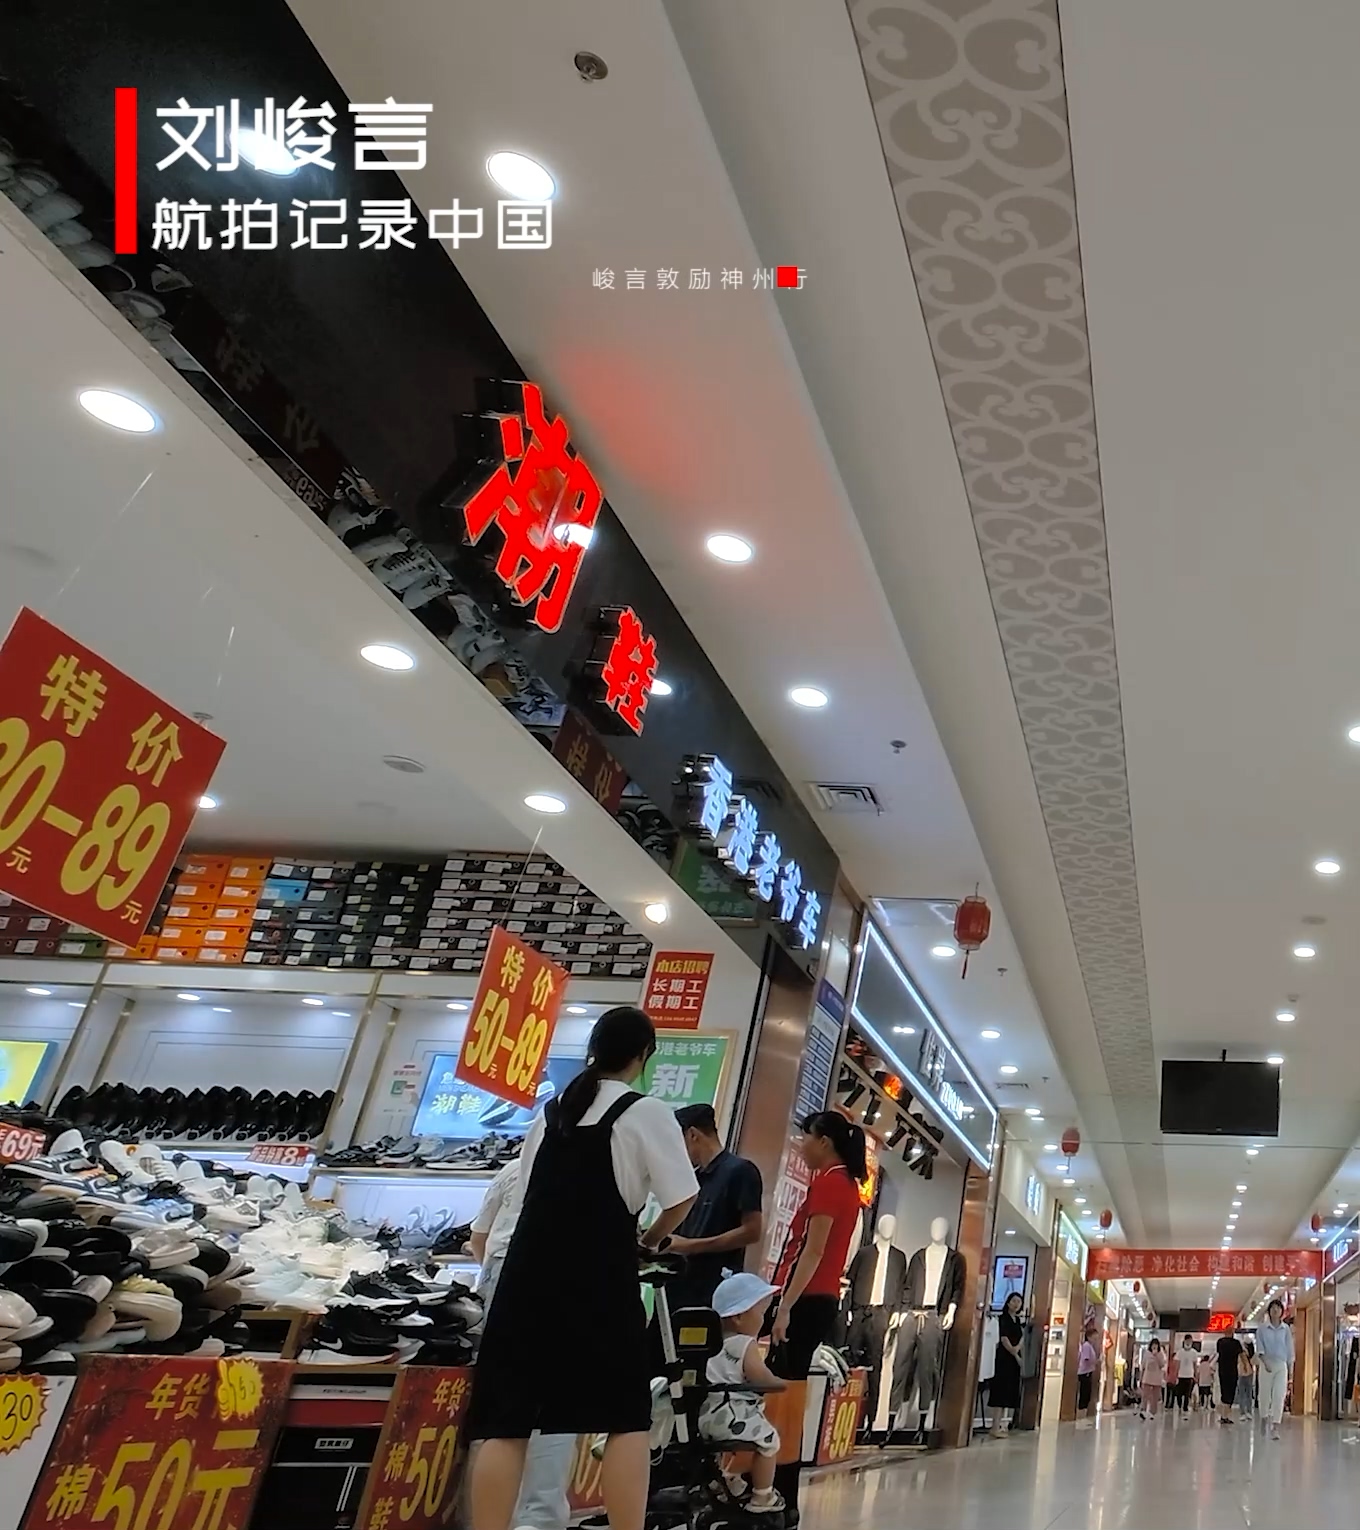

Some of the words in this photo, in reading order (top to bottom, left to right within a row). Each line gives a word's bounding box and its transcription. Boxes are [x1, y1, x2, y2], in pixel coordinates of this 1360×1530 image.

[41, 654, 183, 787] 特价
[701, 757, 821, 950] 香港老爷车
[501, 945, 558, 1012] 特价
[652, 978, 703, 993] 长期工
[655, 959, 710, 975] 本店招聘
[648, 994, 700, 1011] 假期工
[465, 988, 548, 1092] 50-89
[431, 1093, 482, 1116] 潮鞋
[649, 1063, 700, 1099] 新
[1151, 1255, 1200, 1273] 净化社会
[1262, 1255, 1313, 1273] 创建平
[146, 1373, 217, 1420] 年货
[432, 1377, 472, 1418] 年货
[829, 1401, 857, 1460] 99
[45, 1463, 96, 1522] 棉
[91, 1429, 261, 1530] 50元
[400, 1425, 458, 1523] 50
